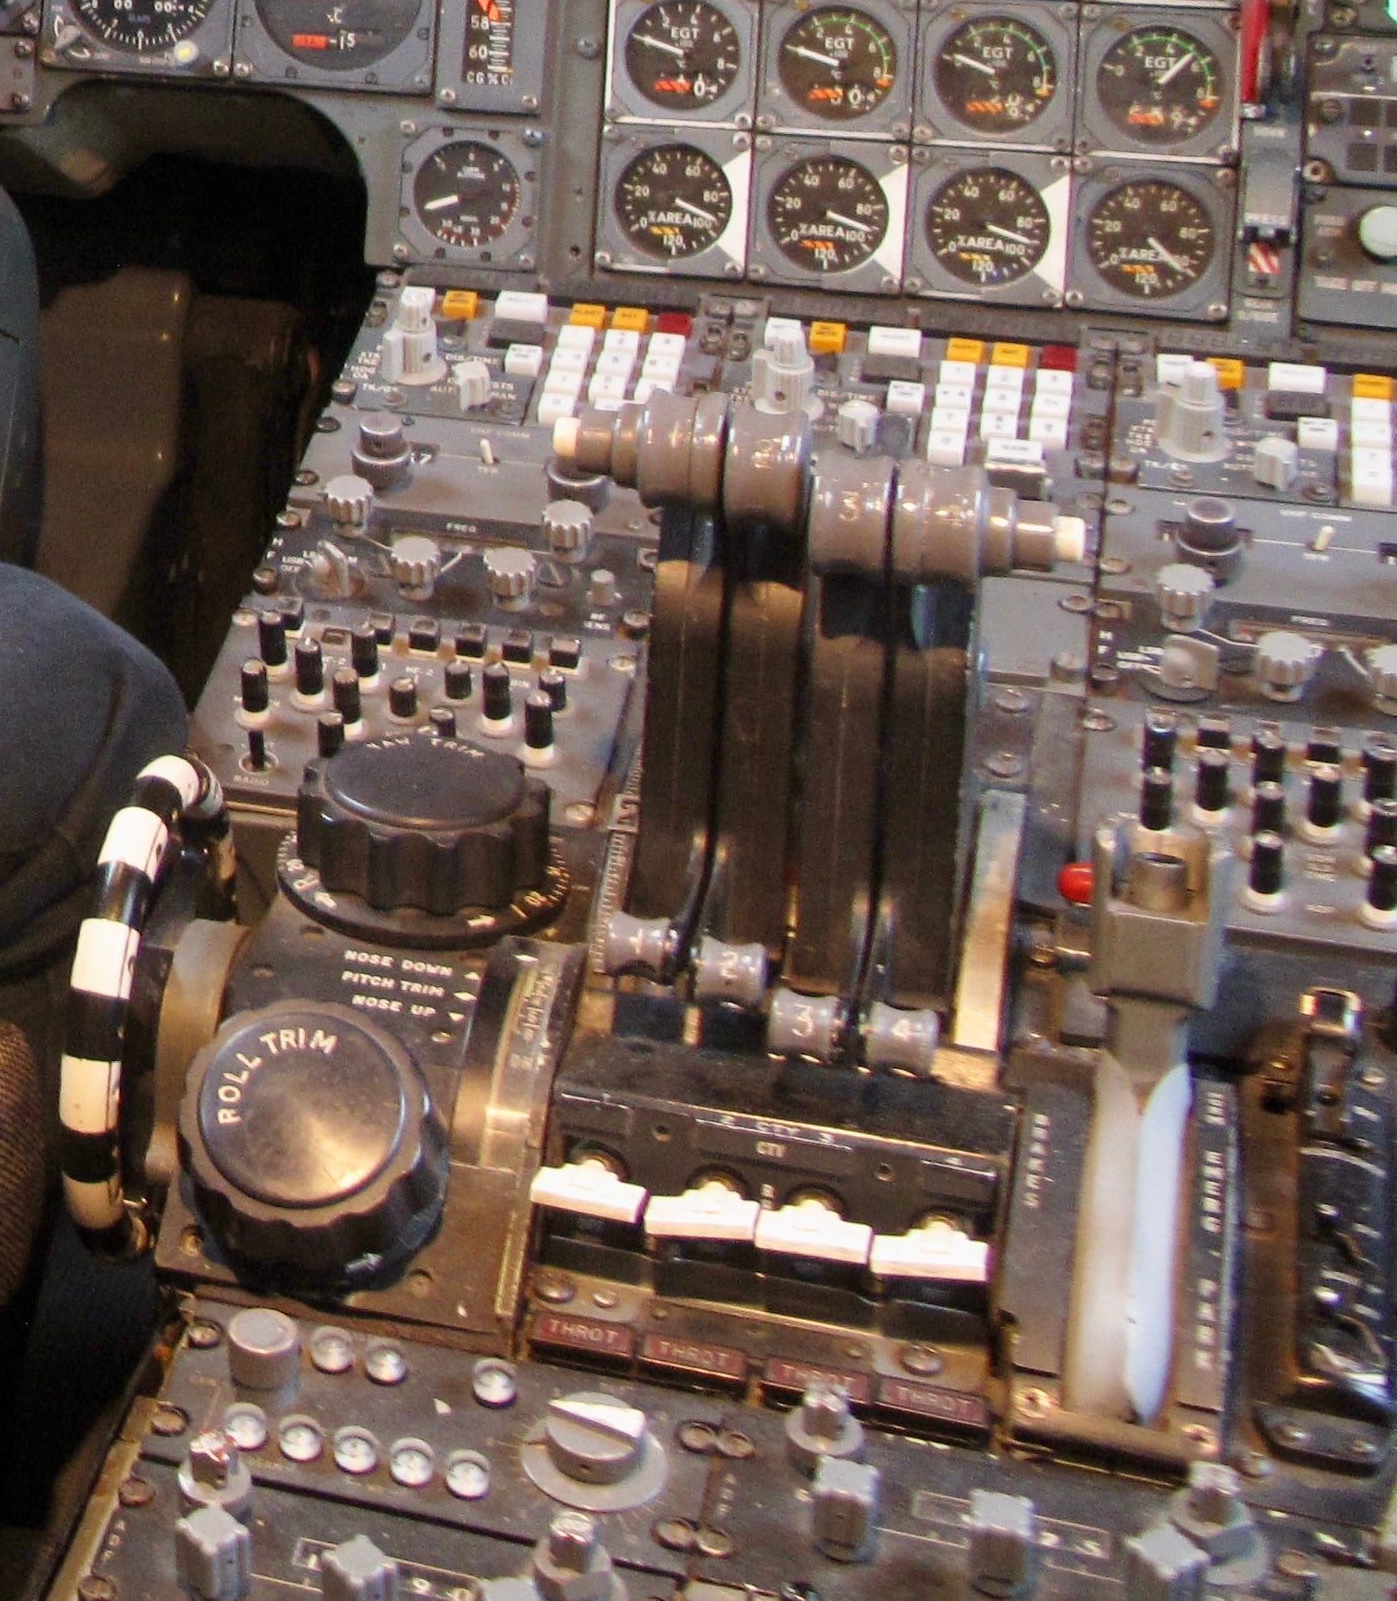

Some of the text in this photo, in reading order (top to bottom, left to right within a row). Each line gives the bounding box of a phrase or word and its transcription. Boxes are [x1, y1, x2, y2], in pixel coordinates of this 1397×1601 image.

[470, 15, 490, 30] 58
[670, 26, 701, 40] EGT
[824, 36, 855, 50] EGT
[468, 45, 488, 60] 60
[982, 46, 1013, 60] EGT
[1144, 56, 1176, 69] EGT
[662, 233, 684, 247] 120
[814, 247, 836, 260] 120
[972, 261, 994, 273] 120
[1134, 271, 1157, 285] 120
[344, 949, 454, 978] NOSE DOWN
[719, 951, 739, 980] 2
[341, 970, 447, 999] PITCH TRIM
[351, 994, 438, 1018] NOSE UP
[791, 1002, 815, 1038] 3
[216, 1026, 340, 1126] ROLL TRIM
[549, 1317, 618, 1344] THROT
[659, 1340, 730, 1369] THROT
[894, 1385, 973, 1414] THROT
